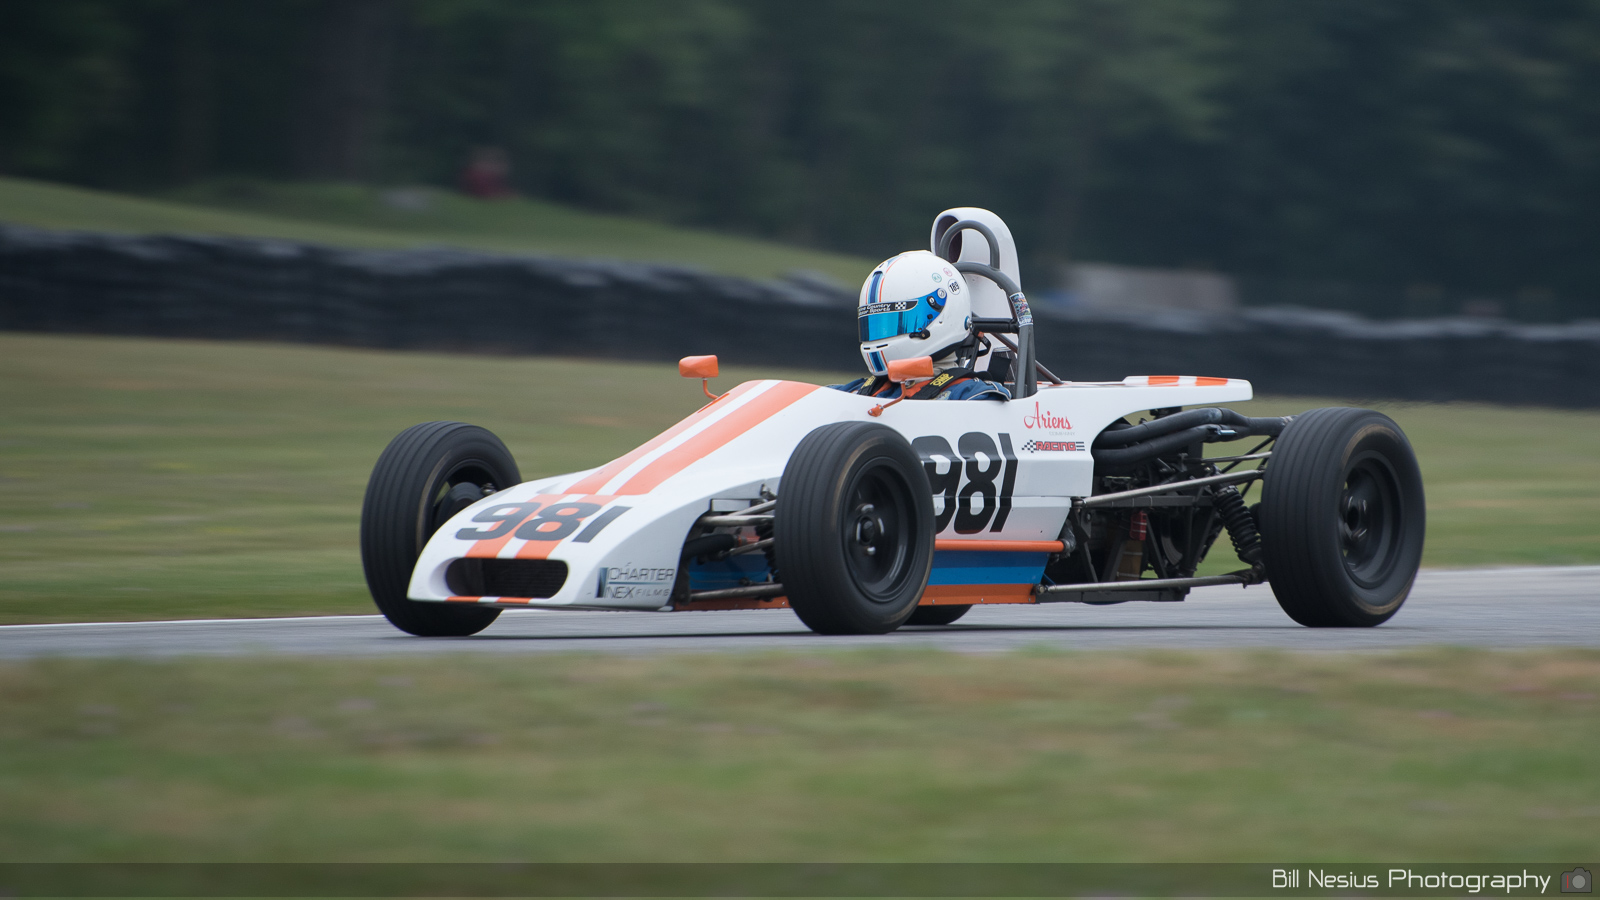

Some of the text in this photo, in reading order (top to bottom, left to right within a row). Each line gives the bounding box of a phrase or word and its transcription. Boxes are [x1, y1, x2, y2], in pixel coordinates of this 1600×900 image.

[1023, 401, 1074, 430] Ariens
[1035, 441, 1077, 452] RACING
[910, 431, 1019, 535] 981
[455, 502, 633, 543] 981
[608, 567, 675, 581] CHARTER
[604, 586, 670, 599] NEX FILMS
